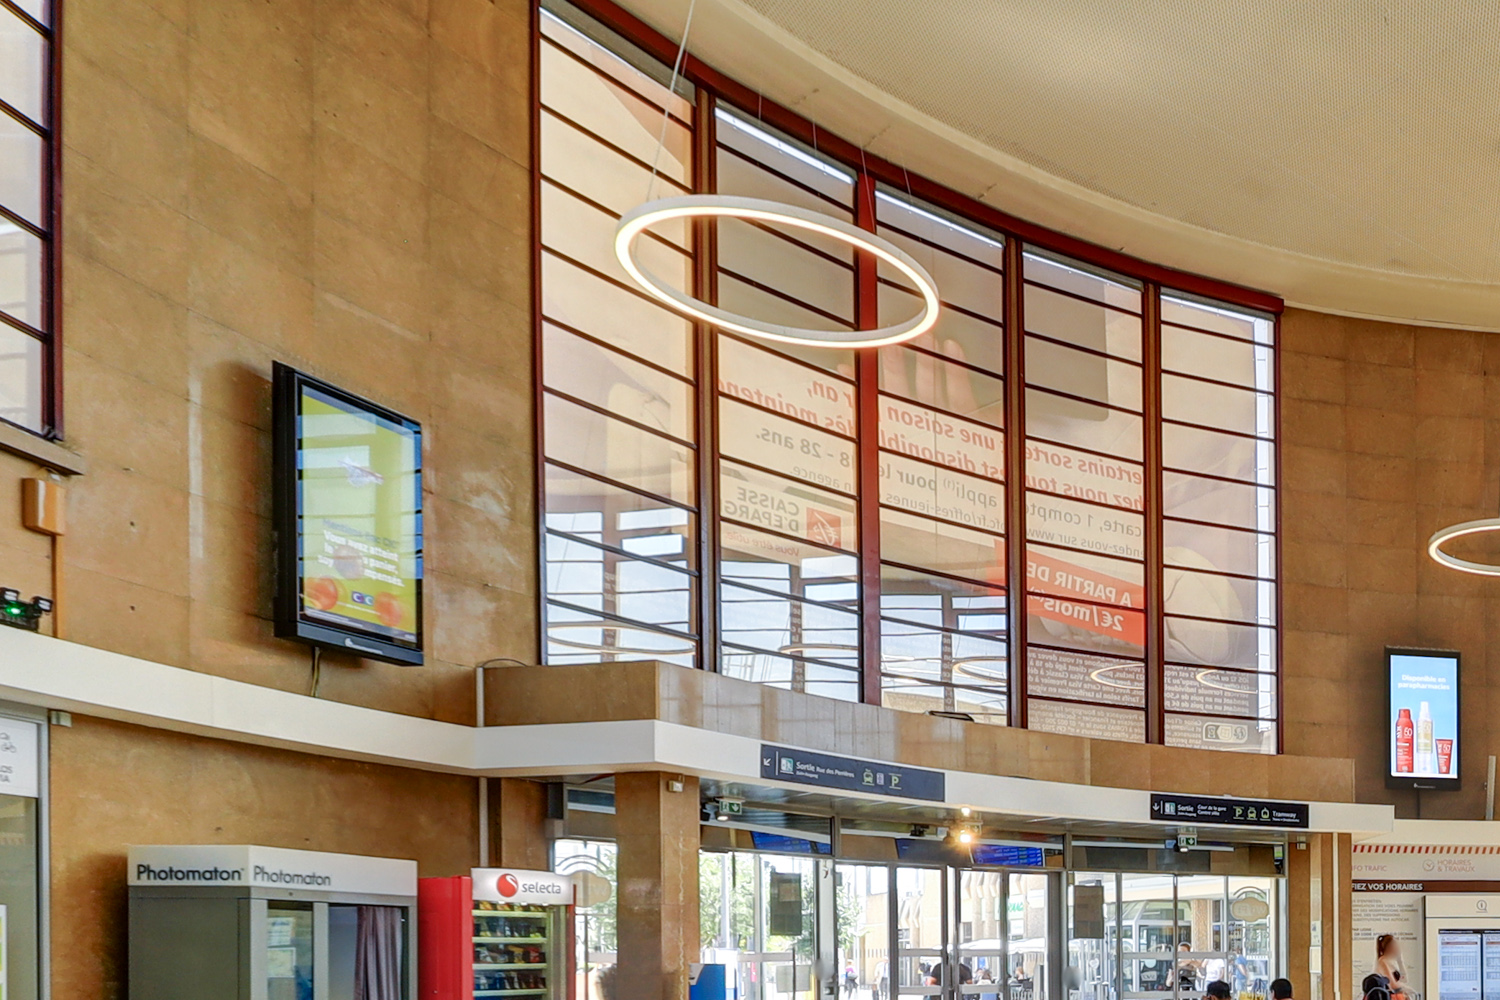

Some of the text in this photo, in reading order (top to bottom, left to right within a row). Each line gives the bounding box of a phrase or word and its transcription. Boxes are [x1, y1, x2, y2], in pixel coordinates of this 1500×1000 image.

[1402, 674, 1436, 683] Disponible
[1398, 682, 1450, 690] parapharmacies
[796, 761, 815, 771] Sortie
[137, 864, 241, 881] Photomaton
[254, 865, 330, 886] Photomaton
[522, 882, 561, 894] selecta
[1386, 883, 1423, 891] HORAIRES
